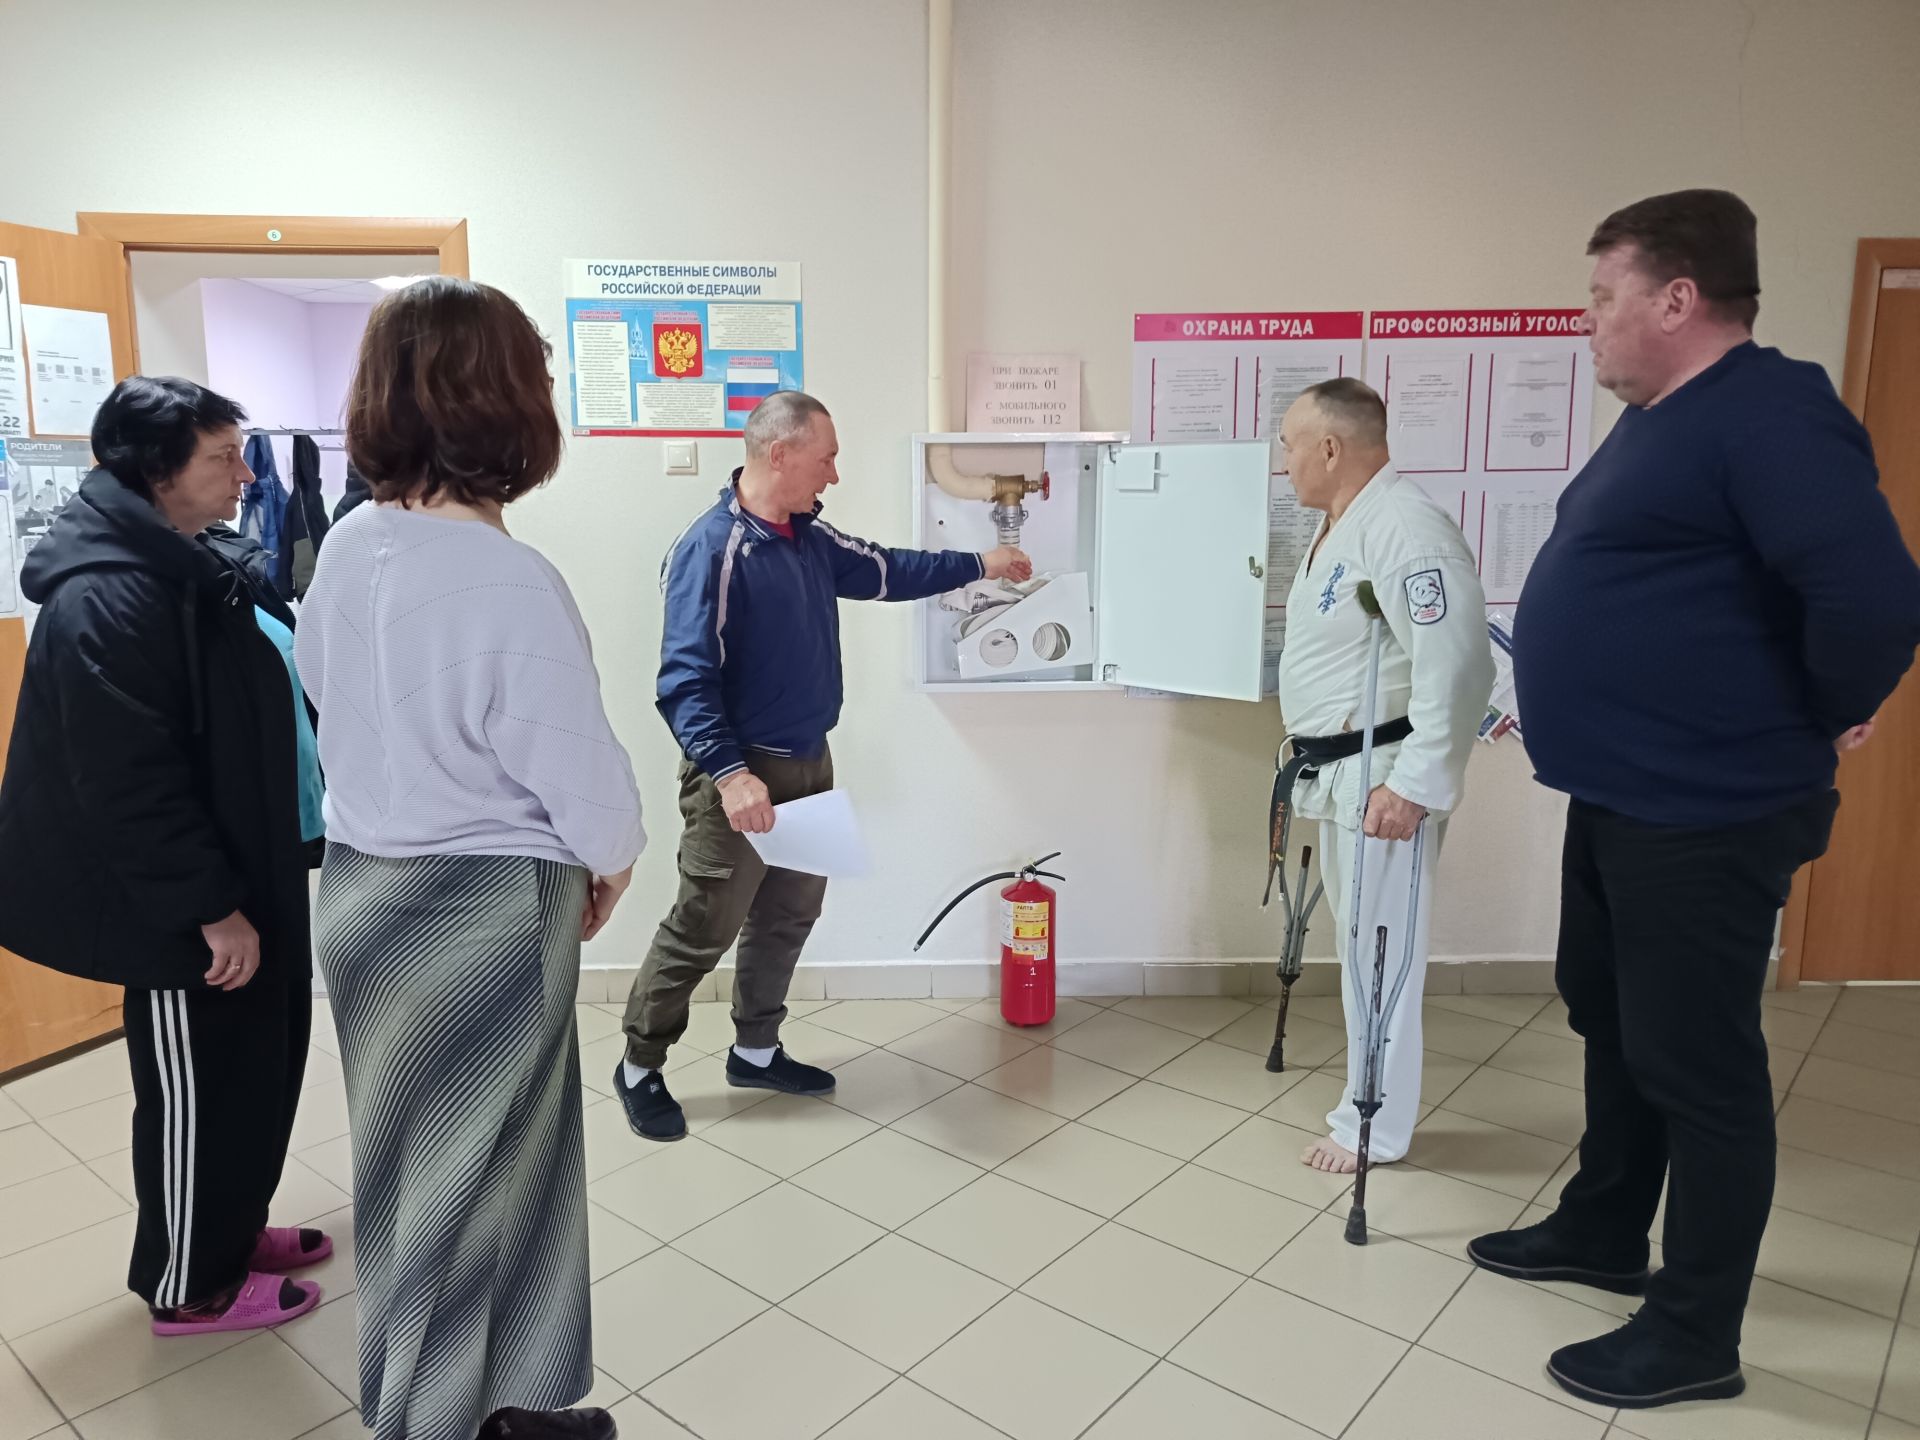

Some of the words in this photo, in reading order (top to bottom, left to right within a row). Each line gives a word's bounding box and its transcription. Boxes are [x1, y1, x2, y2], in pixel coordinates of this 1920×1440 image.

[587, 264, 710, 278] ГОСУДАРСТВЕННЫЕ
[712, 265, 777, 278] СИМВОЛЫ
[601, 281, 684, 295] РОССИЙСКОЙ
[686, 283, 761, 297] ФЕДЕРАЦИИ
[1182, 319, 1255, 336] ОХРАНА
[1259, 318, 1314, 337] ТРУДА
[1373, 312, 1521, 334] ПРОФСОЮЗНЫЙ
[992, 366, 1012, 375] ПРИ
[1019, 366, 1060, 375] ПОЖАРЕ
[994, 381, 1038, 391] ЗВОНИТЬ
[1044, 380, 1057, 390] 01
[985, 402, 992, 410] С
[999, 401, 1066, 410] МОБИЛЬНОГО
[0, 415, 20, 429] 22
[991, 416, 1034, 425] ЗВОНИТЬ
[1043, 414, 1061, 425] 112
[10, 442, 62, 451] РОДИТЕЛИ
[1030, 966, 1037, 976] 1
